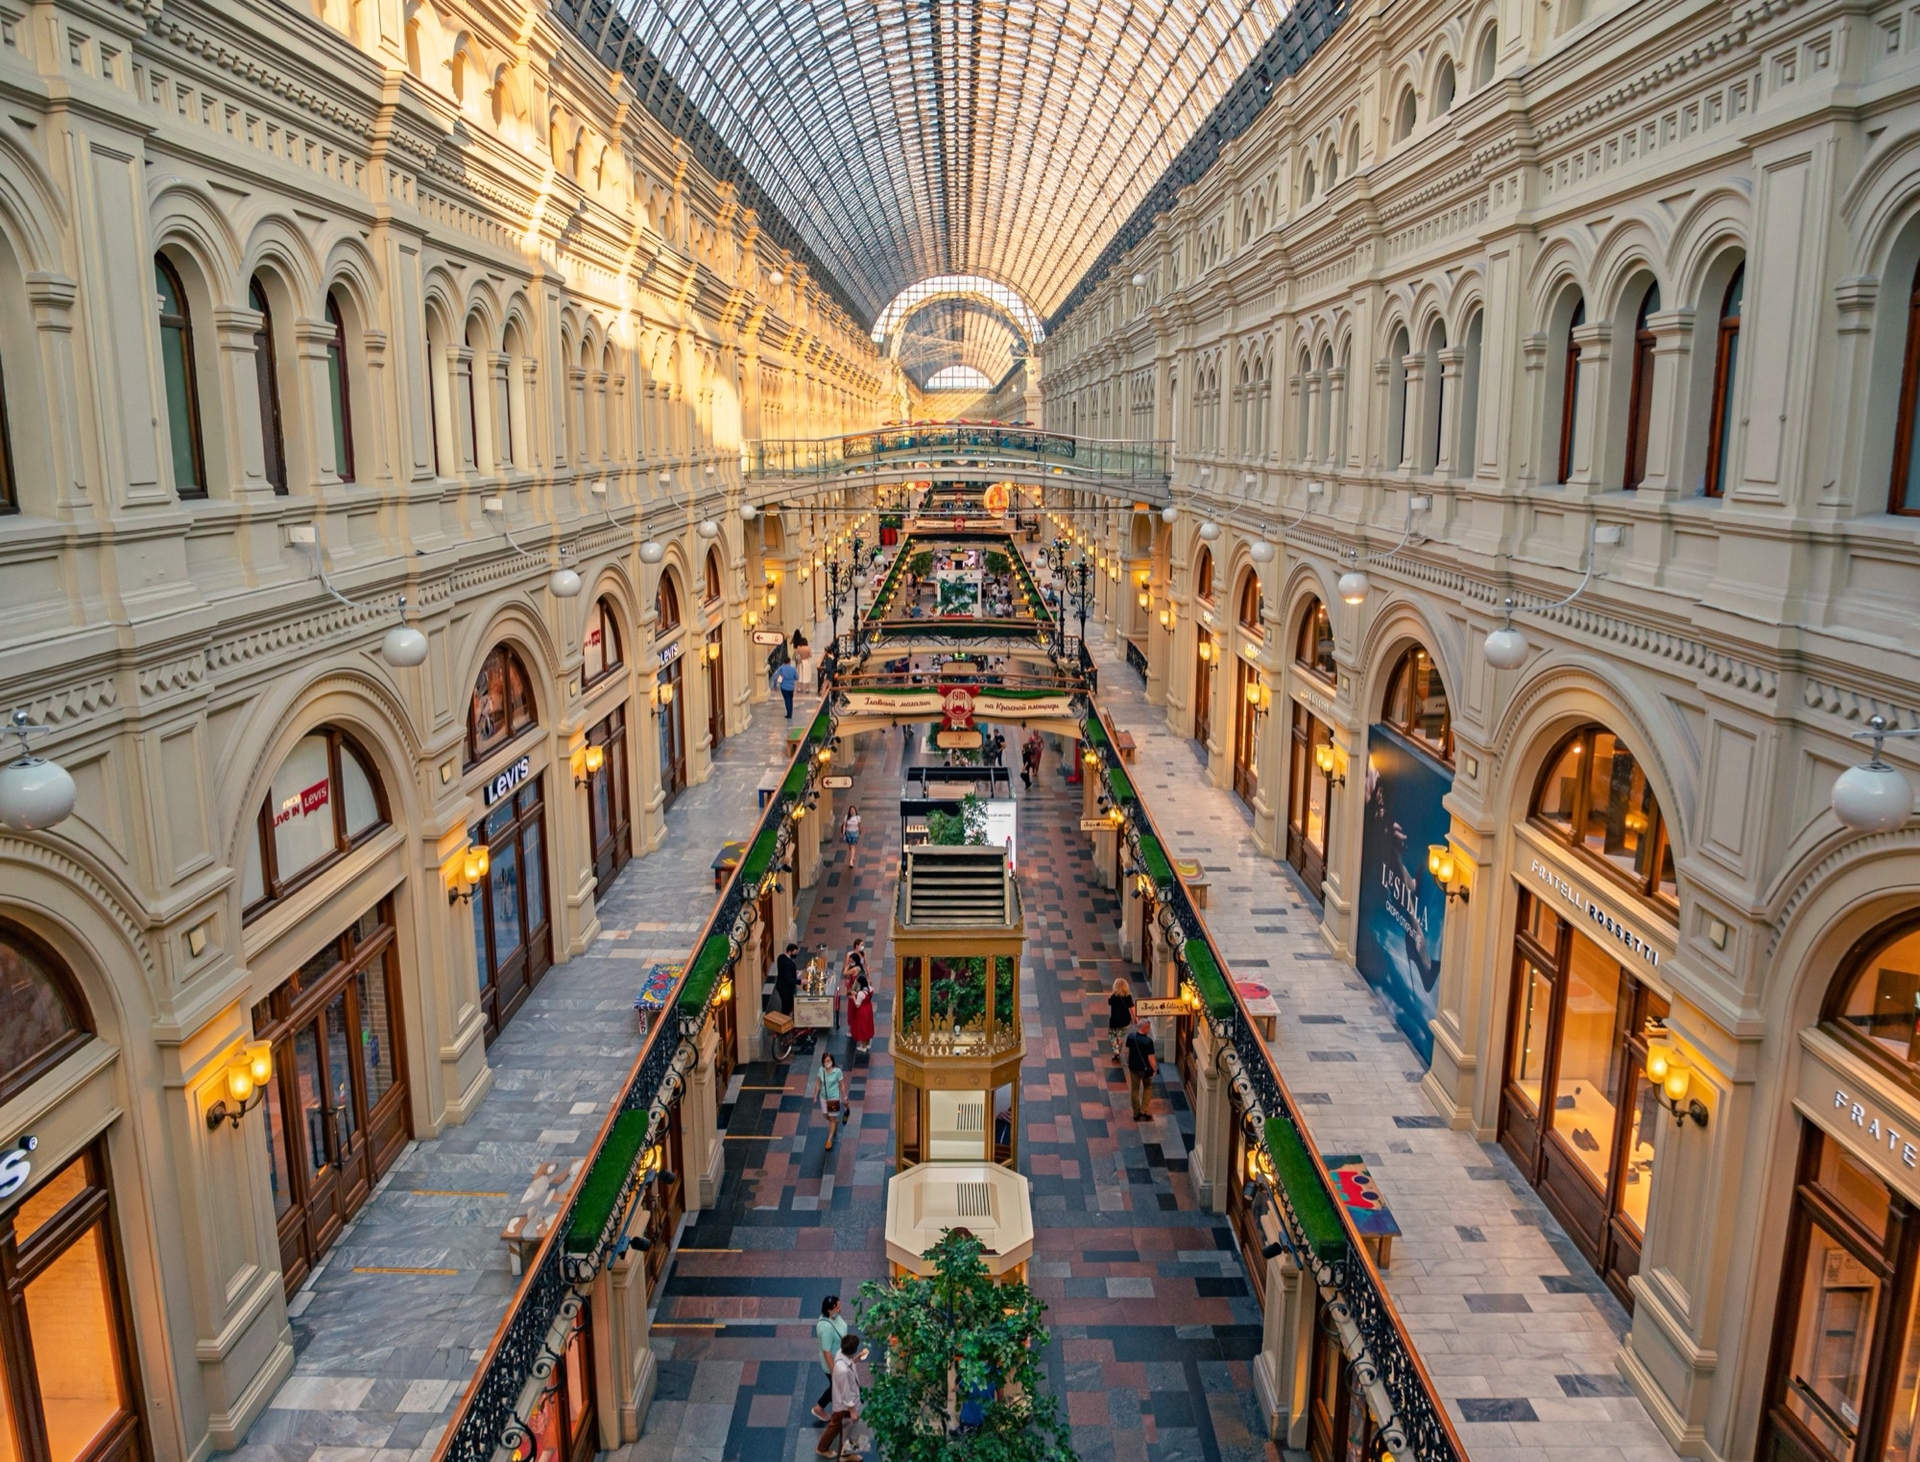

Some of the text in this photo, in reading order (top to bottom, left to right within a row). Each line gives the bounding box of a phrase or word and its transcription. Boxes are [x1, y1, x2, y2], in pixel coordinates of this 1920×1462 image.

[864, 696, 932, 708] Главный магазин
[984, 702, 995, 710] на
[995, 701, 1027, 713] Красной
[1531, 859, 1660, 968] FRATELLI ROSSETTI
[1834, 1089, 1919, 1169] FRATE
